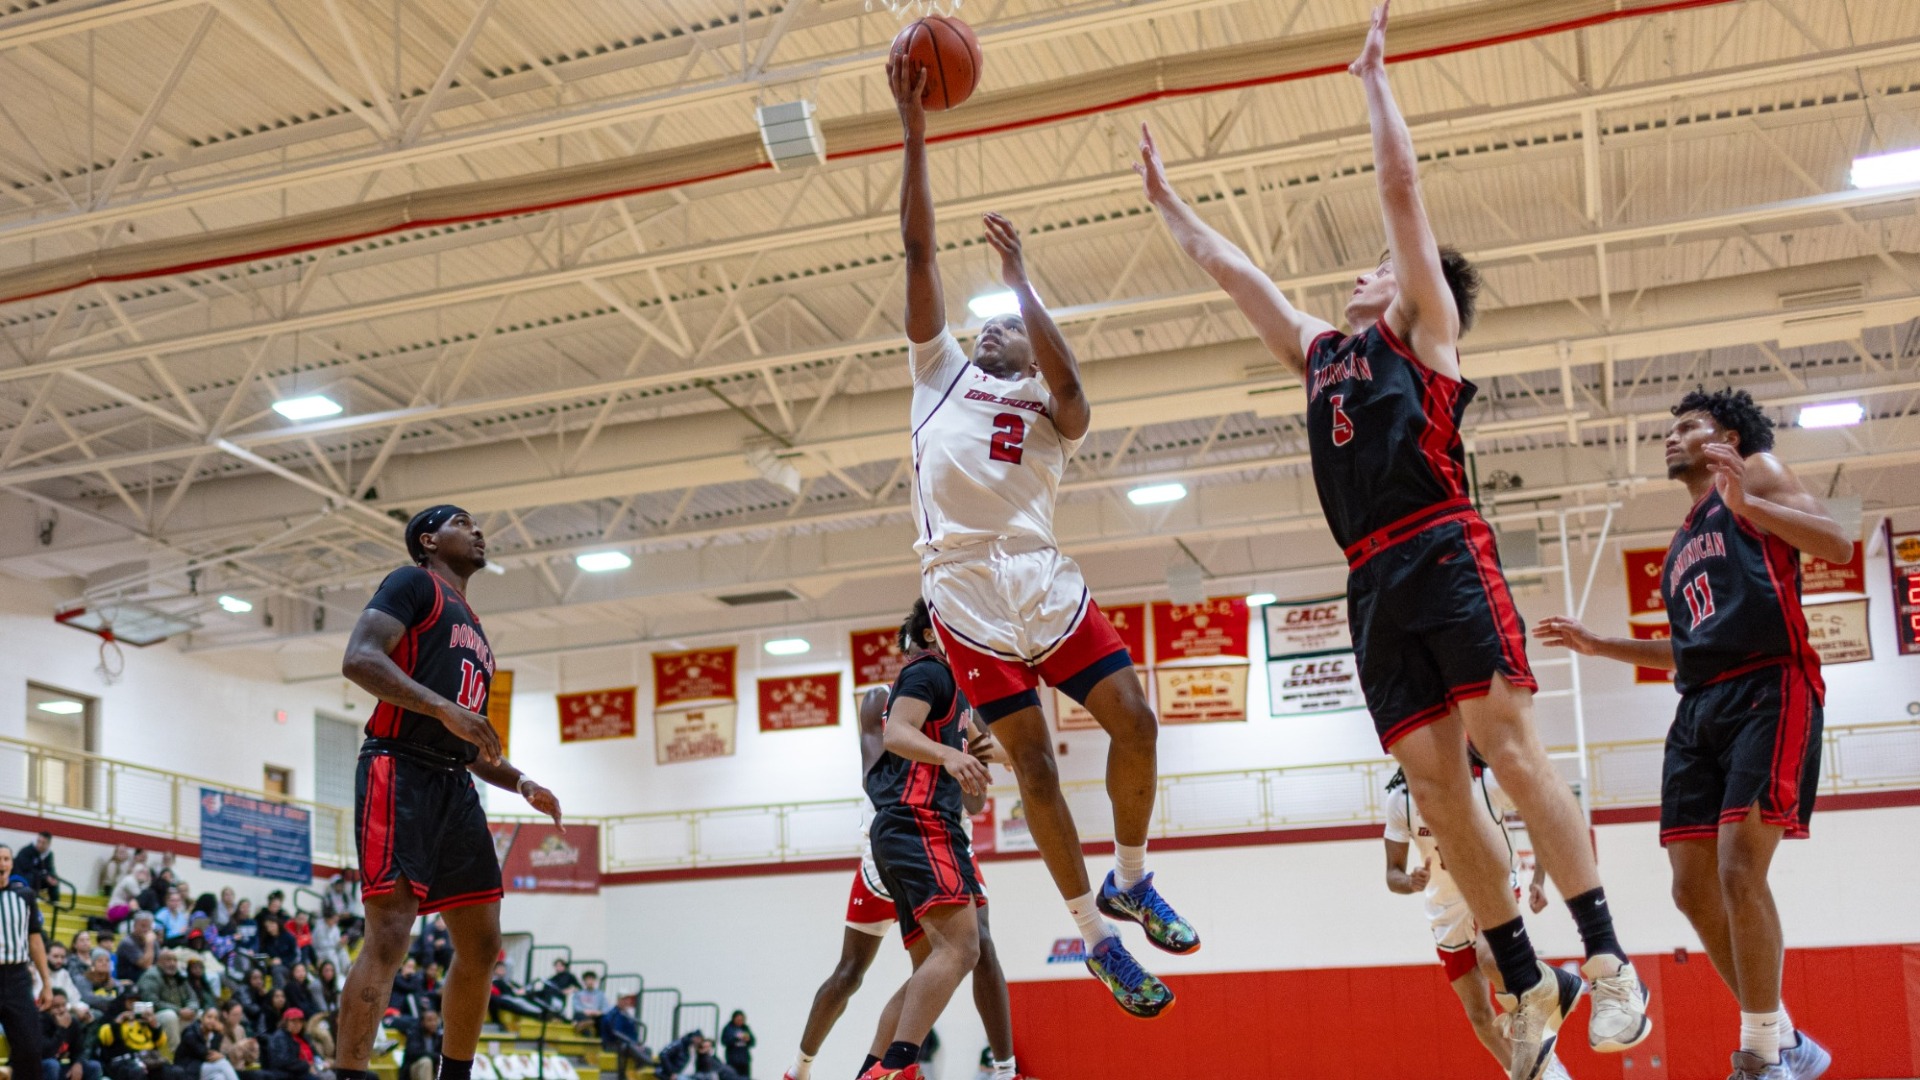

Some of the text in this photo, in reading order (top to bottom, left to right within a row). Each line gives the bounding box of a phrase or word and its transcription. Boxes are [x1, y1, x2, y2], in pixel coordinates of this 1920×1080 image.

[989, 413, 1025, 465] 2
[1330, 394, 1354, 447] 5
[1669, 532, 1726, 598] DOMINICAN
[1286, 605, 1339, 624] CACC
[1683, 571, 1715, 632] 11
[449, 623, 494, 678] DOMINICA
[1292, 660, 1343, 677] CACC
[457, 658, 487, 714] 10
